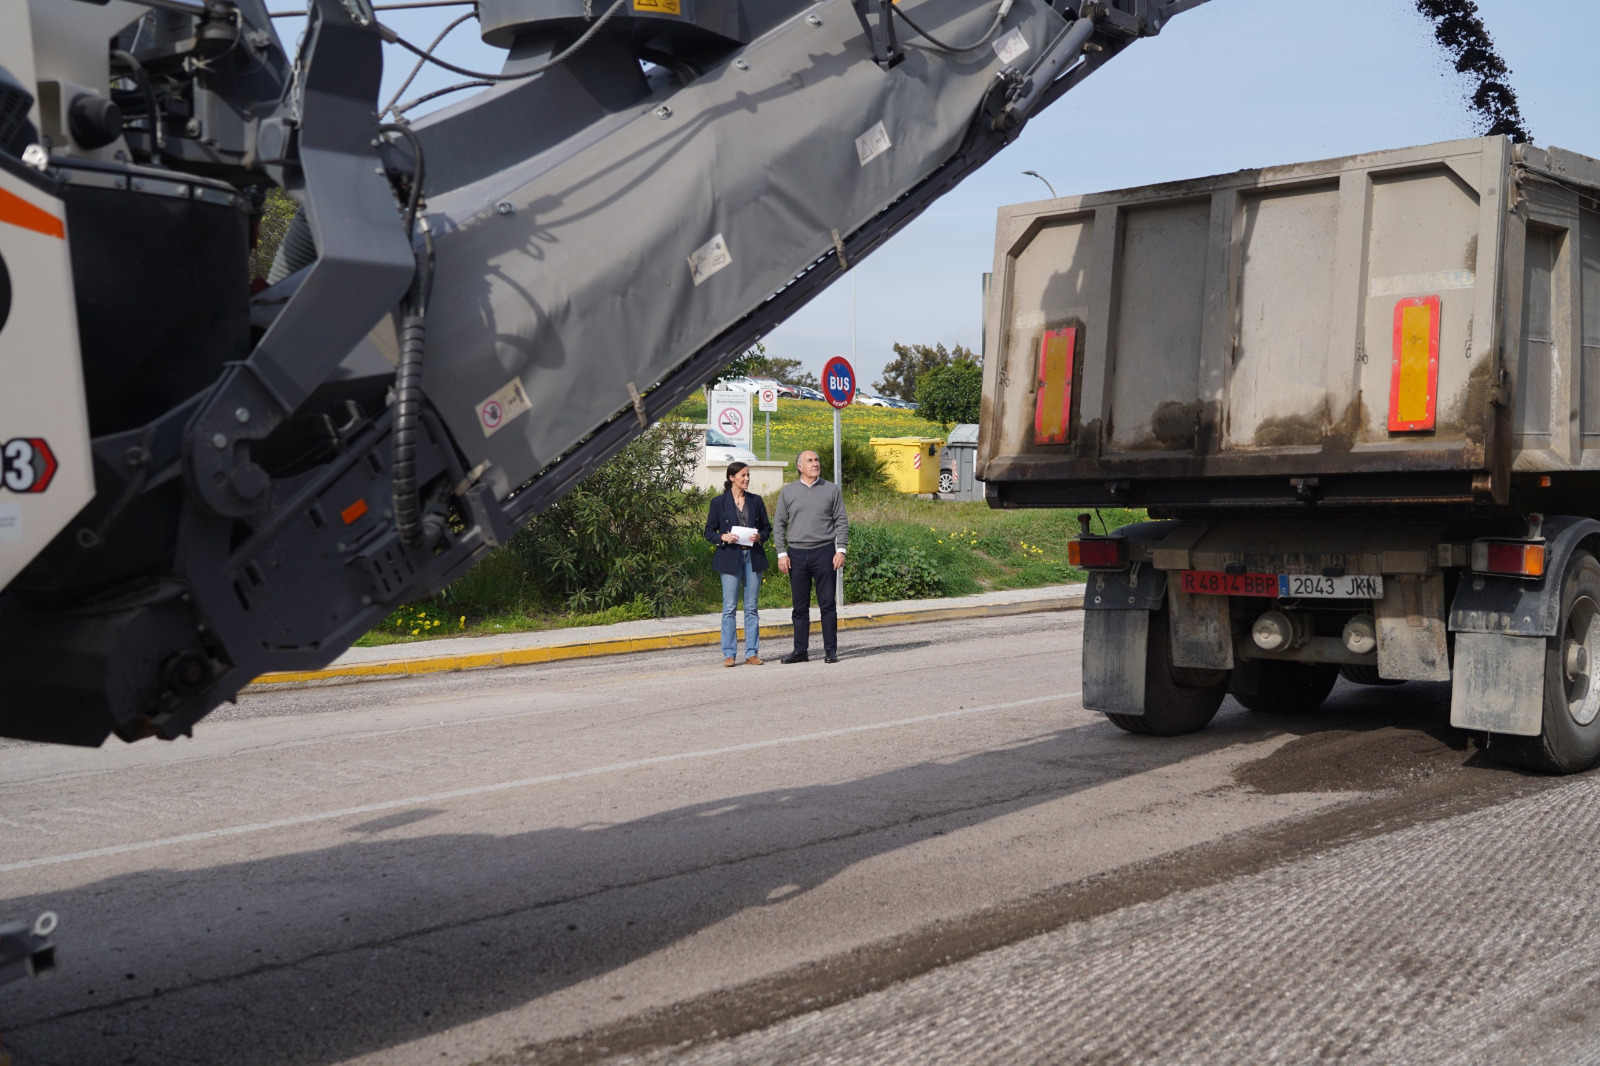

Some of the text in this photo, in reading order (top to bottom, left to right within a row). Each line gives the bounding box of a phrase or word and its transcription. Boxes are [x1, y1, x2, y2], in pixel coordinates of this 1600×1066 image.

[829, 375, 850, 391] BUS
[0, 438, 35, 492] 3
[1185, 573, 1275, 593] R 4814 BBP
[1294, 576, 1377, 596] 2043 JKN
